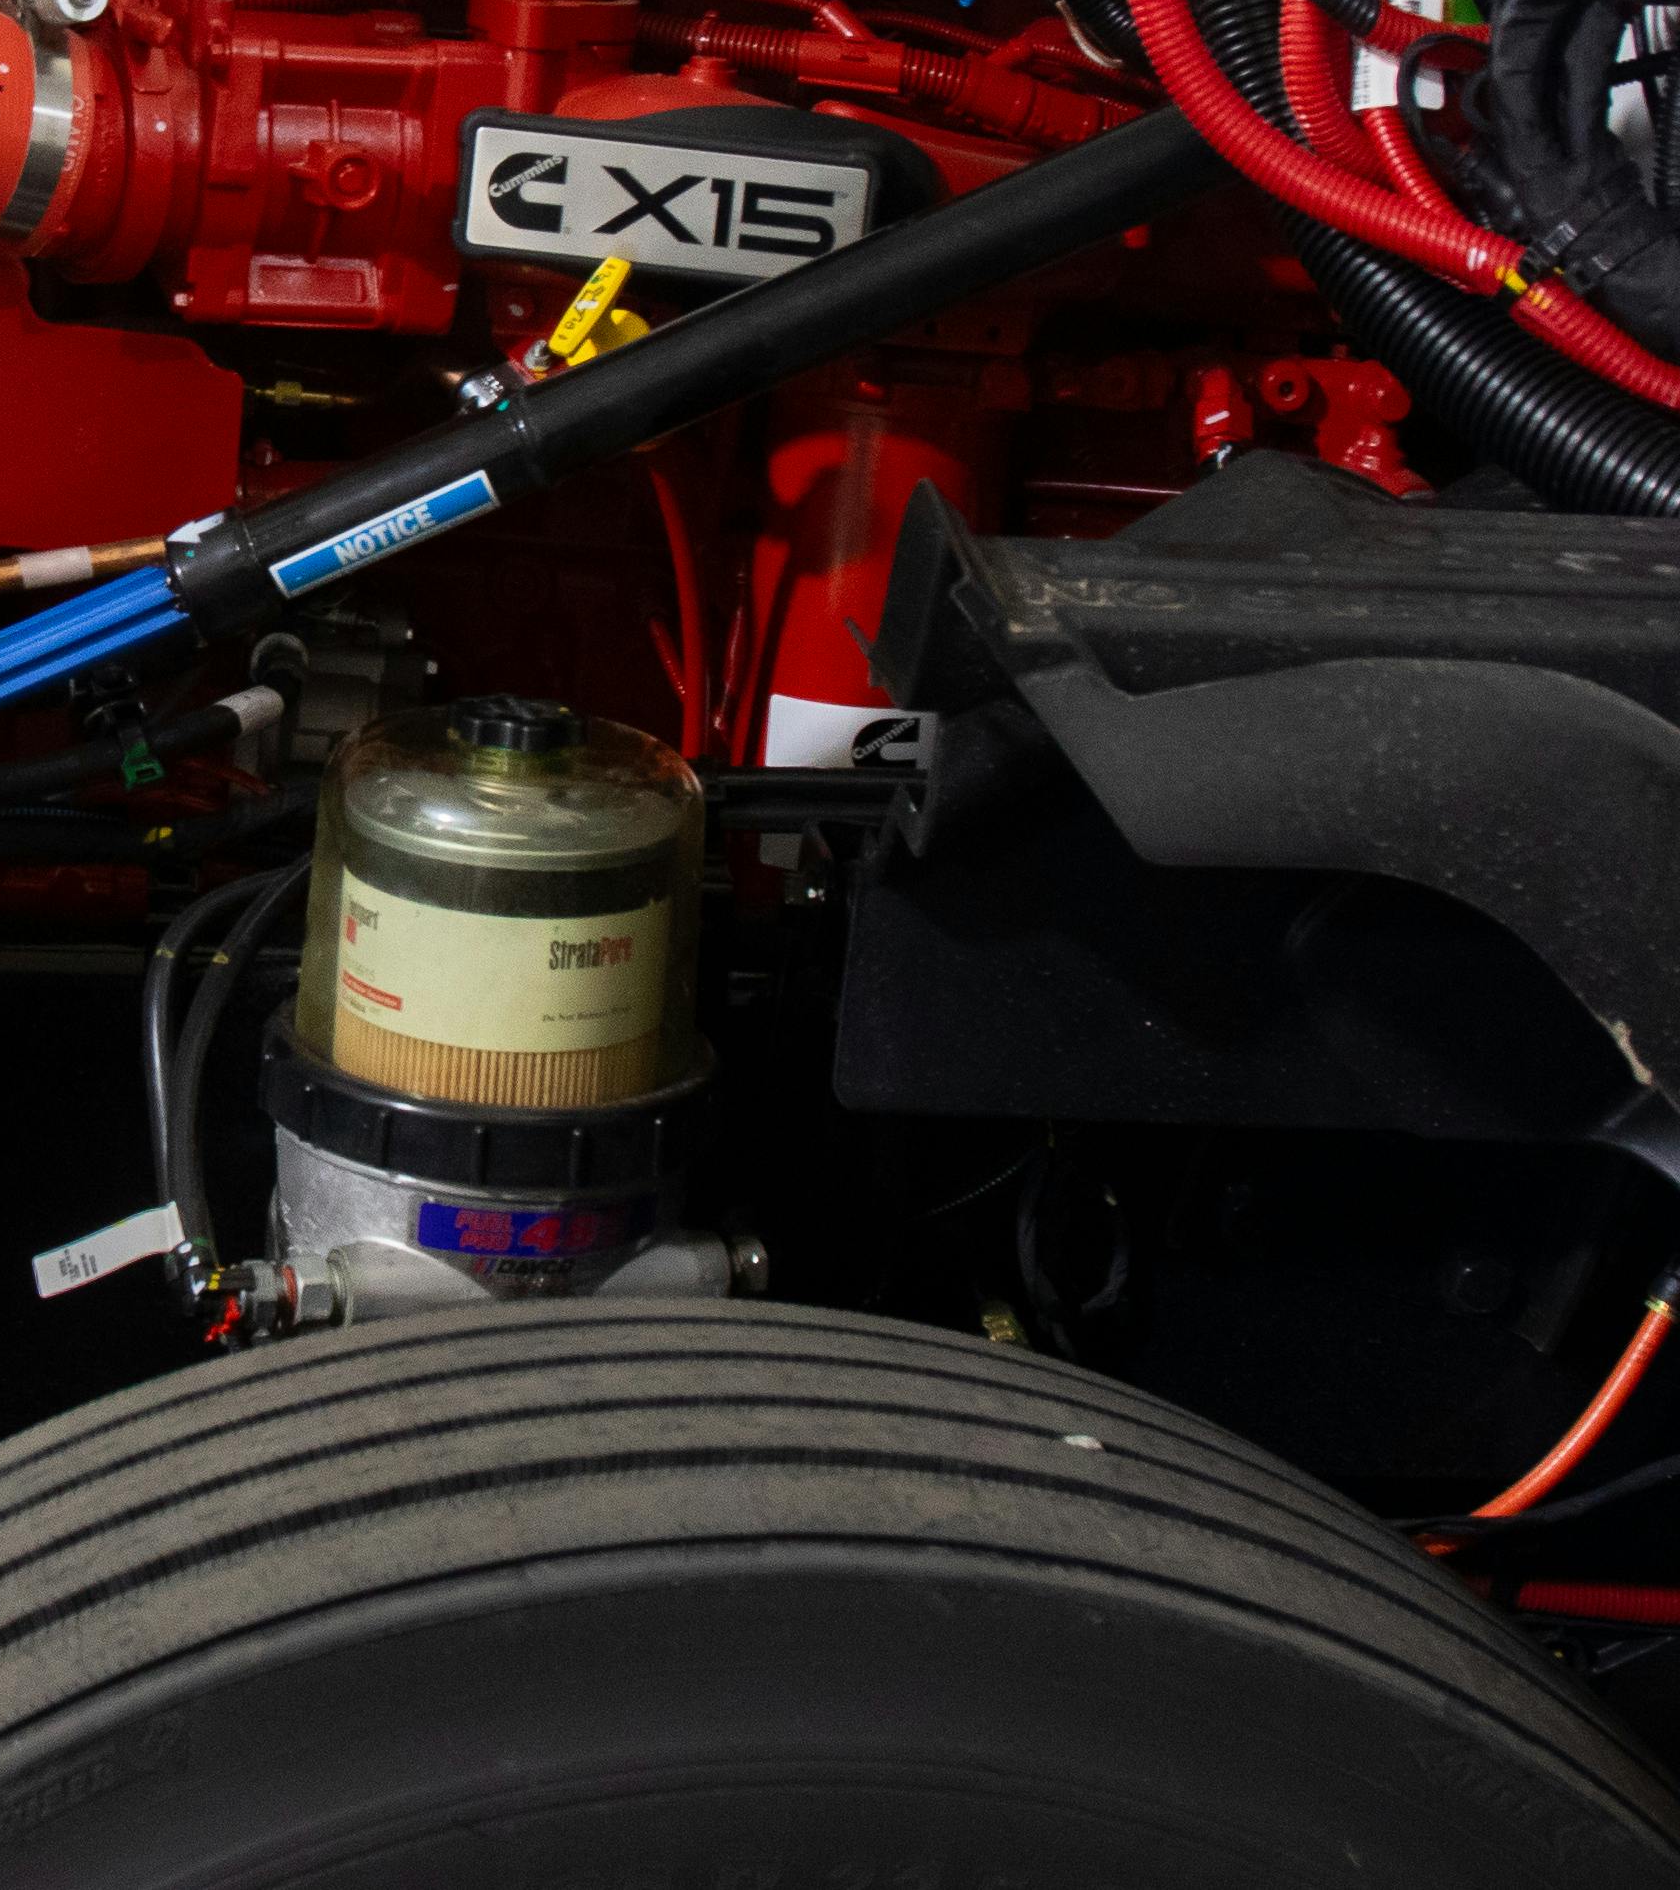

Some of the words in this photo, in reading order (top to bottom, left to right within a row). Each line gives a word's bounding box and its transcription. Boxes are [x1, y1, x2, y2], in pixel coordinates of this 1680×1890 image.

[488, 153, 564, 199] Cummins
[592, 164, 837, 257] X15
[332, 502, 436, 566] NOTICE
[852, 719, 915, 759] Cummins
[548, 936, 633, 971] StrataPore
